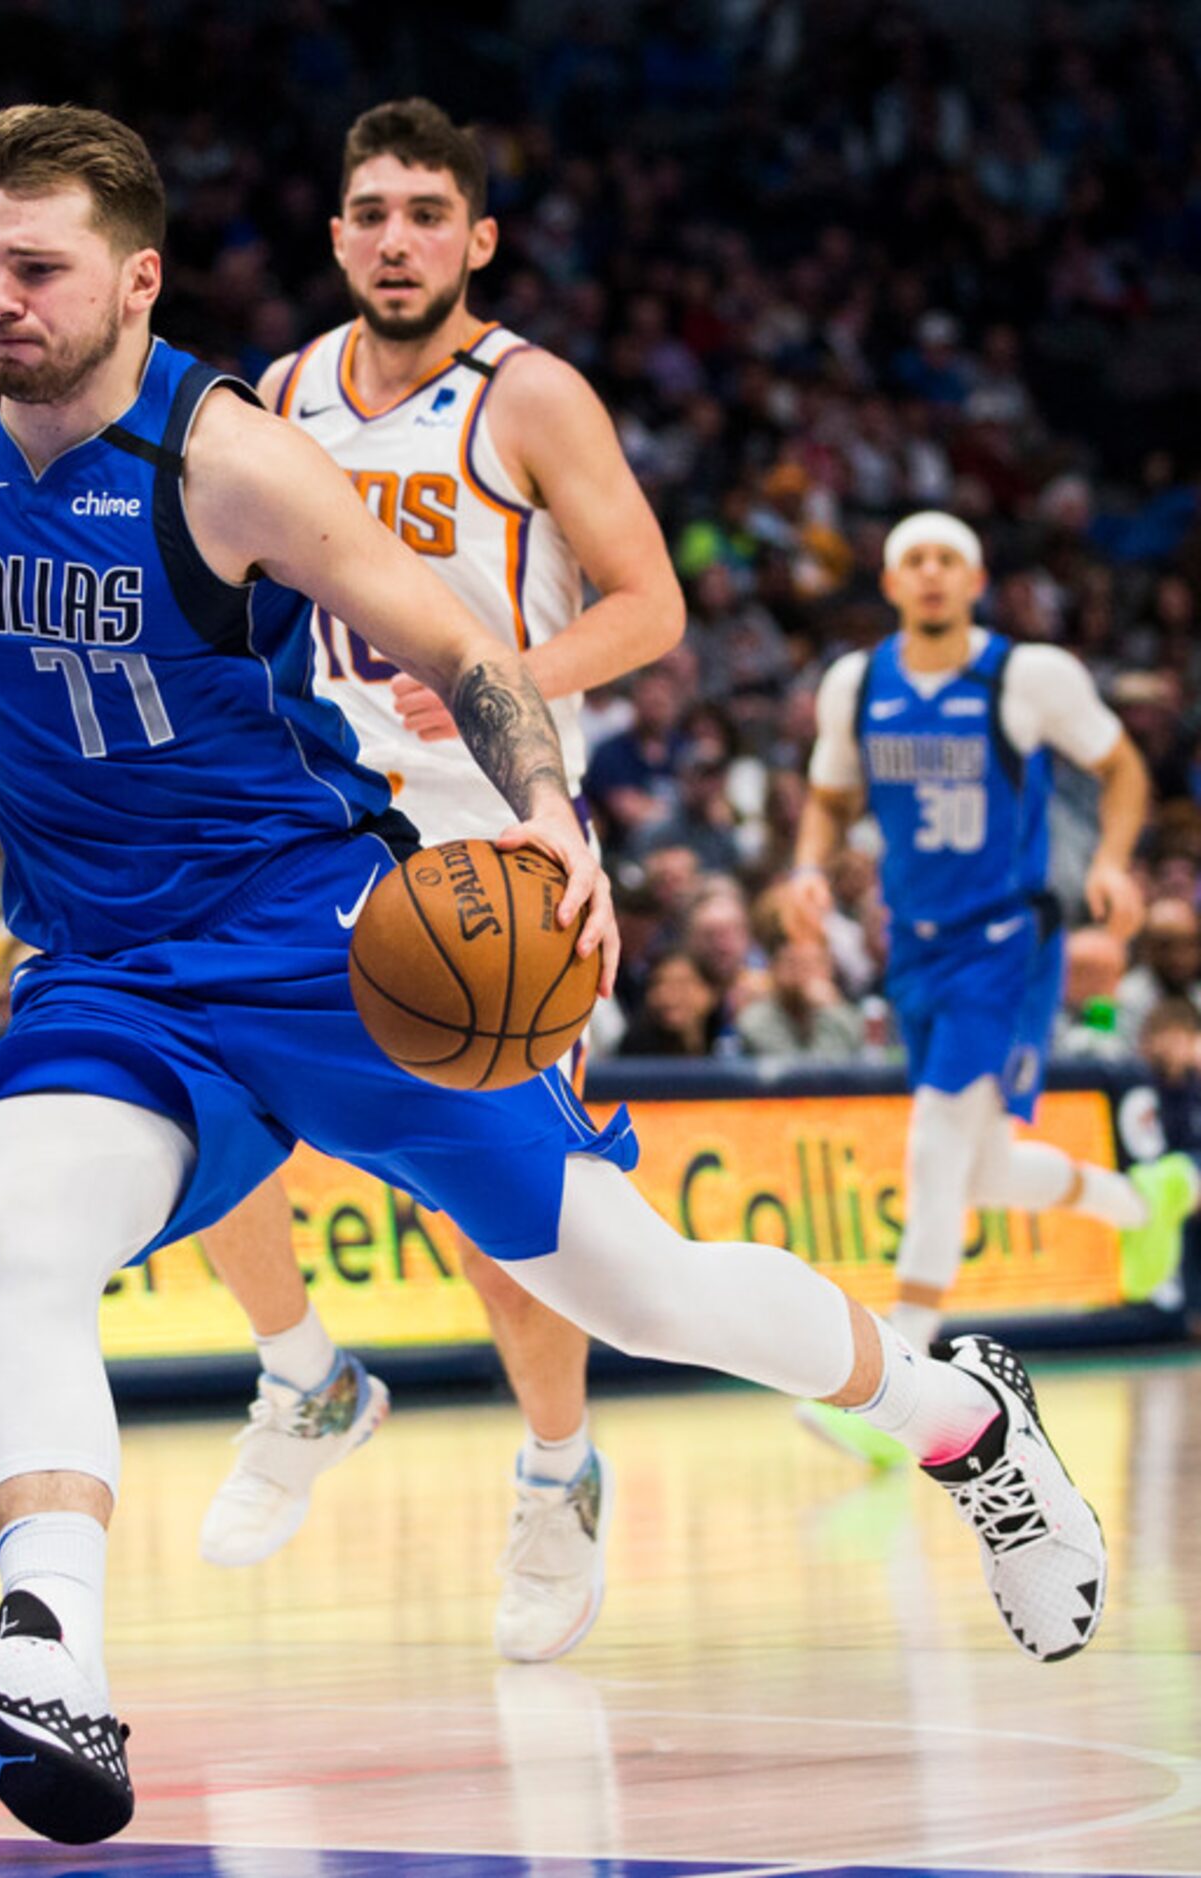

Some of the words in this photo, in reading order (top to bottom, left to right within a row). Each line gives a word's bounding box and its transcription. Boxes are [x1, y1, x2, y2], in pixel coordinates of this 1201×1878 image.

[71, 490, 141, 517] chime
[30, 646, 175, 759] 77
[914, 783, 987, 853] 30
